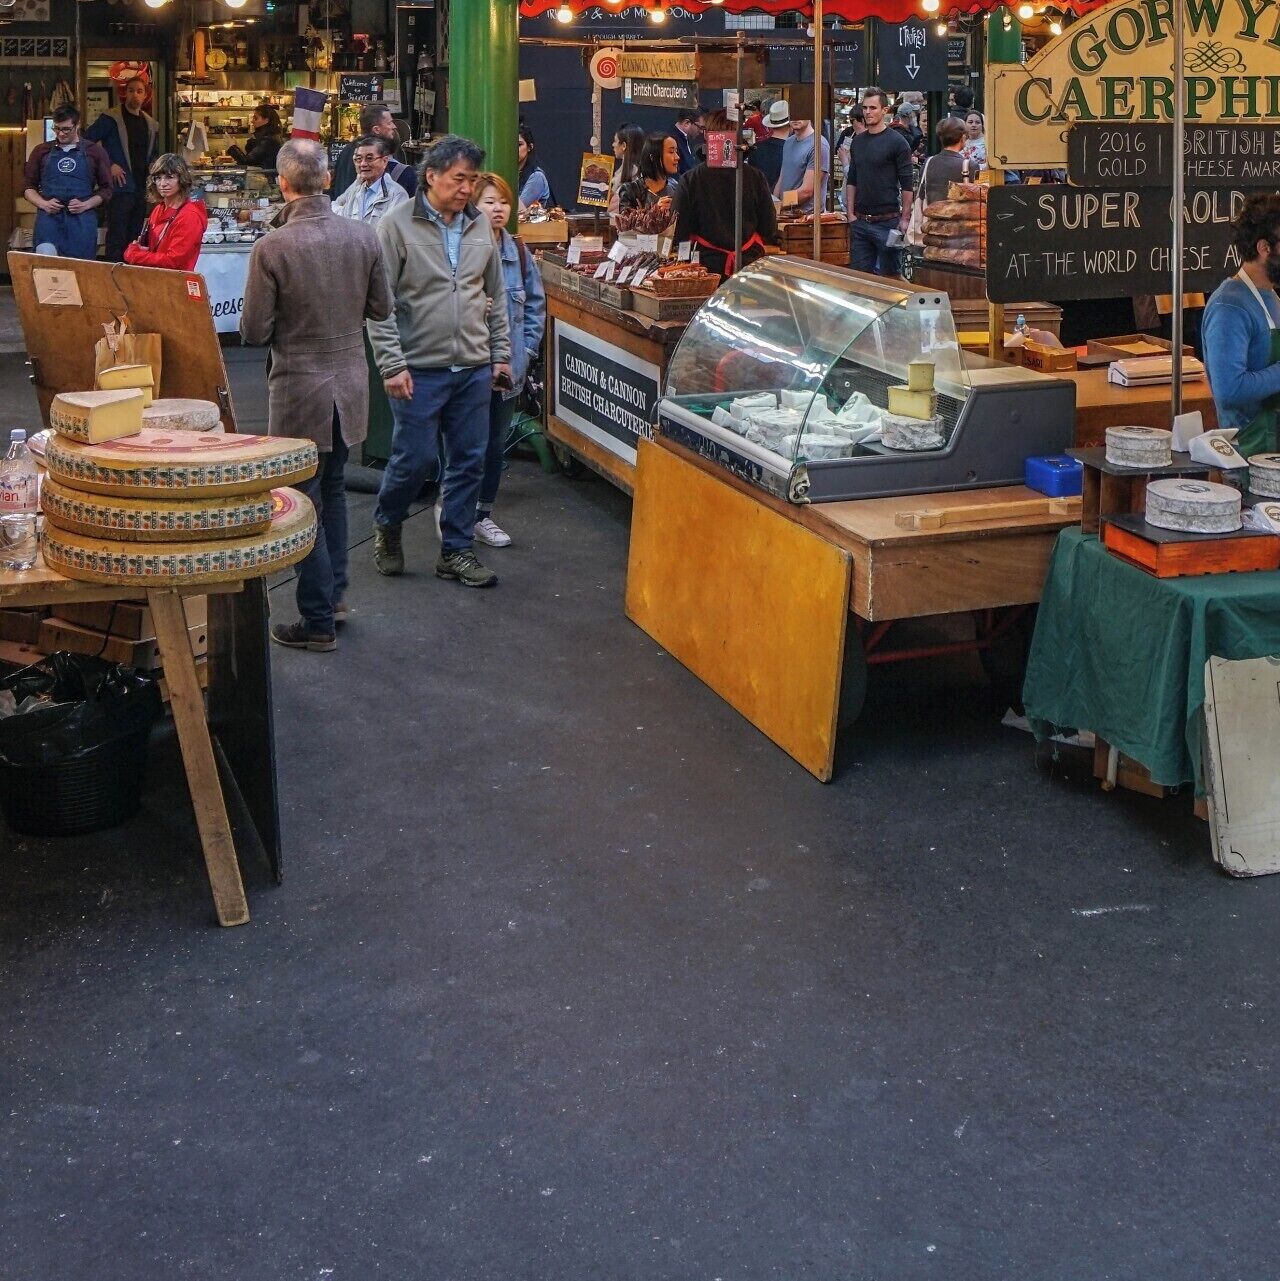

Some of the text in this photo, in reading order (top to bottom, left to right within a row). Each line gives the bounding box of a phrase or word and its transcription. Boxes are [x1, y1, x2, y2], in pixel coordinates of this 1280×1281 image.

[633, 82, 688, 99] British Charcuterie
[1098, 131, 1147, 153] 2016
[1182, 129, 1265, 156] BRITISH
[1098, 157, 1147, 177] GOLD
[1183, 160, 1235, 177] HEESE
[1037, 192, 1141, 231] SUPER
[1083, 249, 1137, 275] WORLD
[565, 353, 647, 411] CANNON & CANNON
[561, 375, 655, 442] BRITISH CHARCUTERIE
